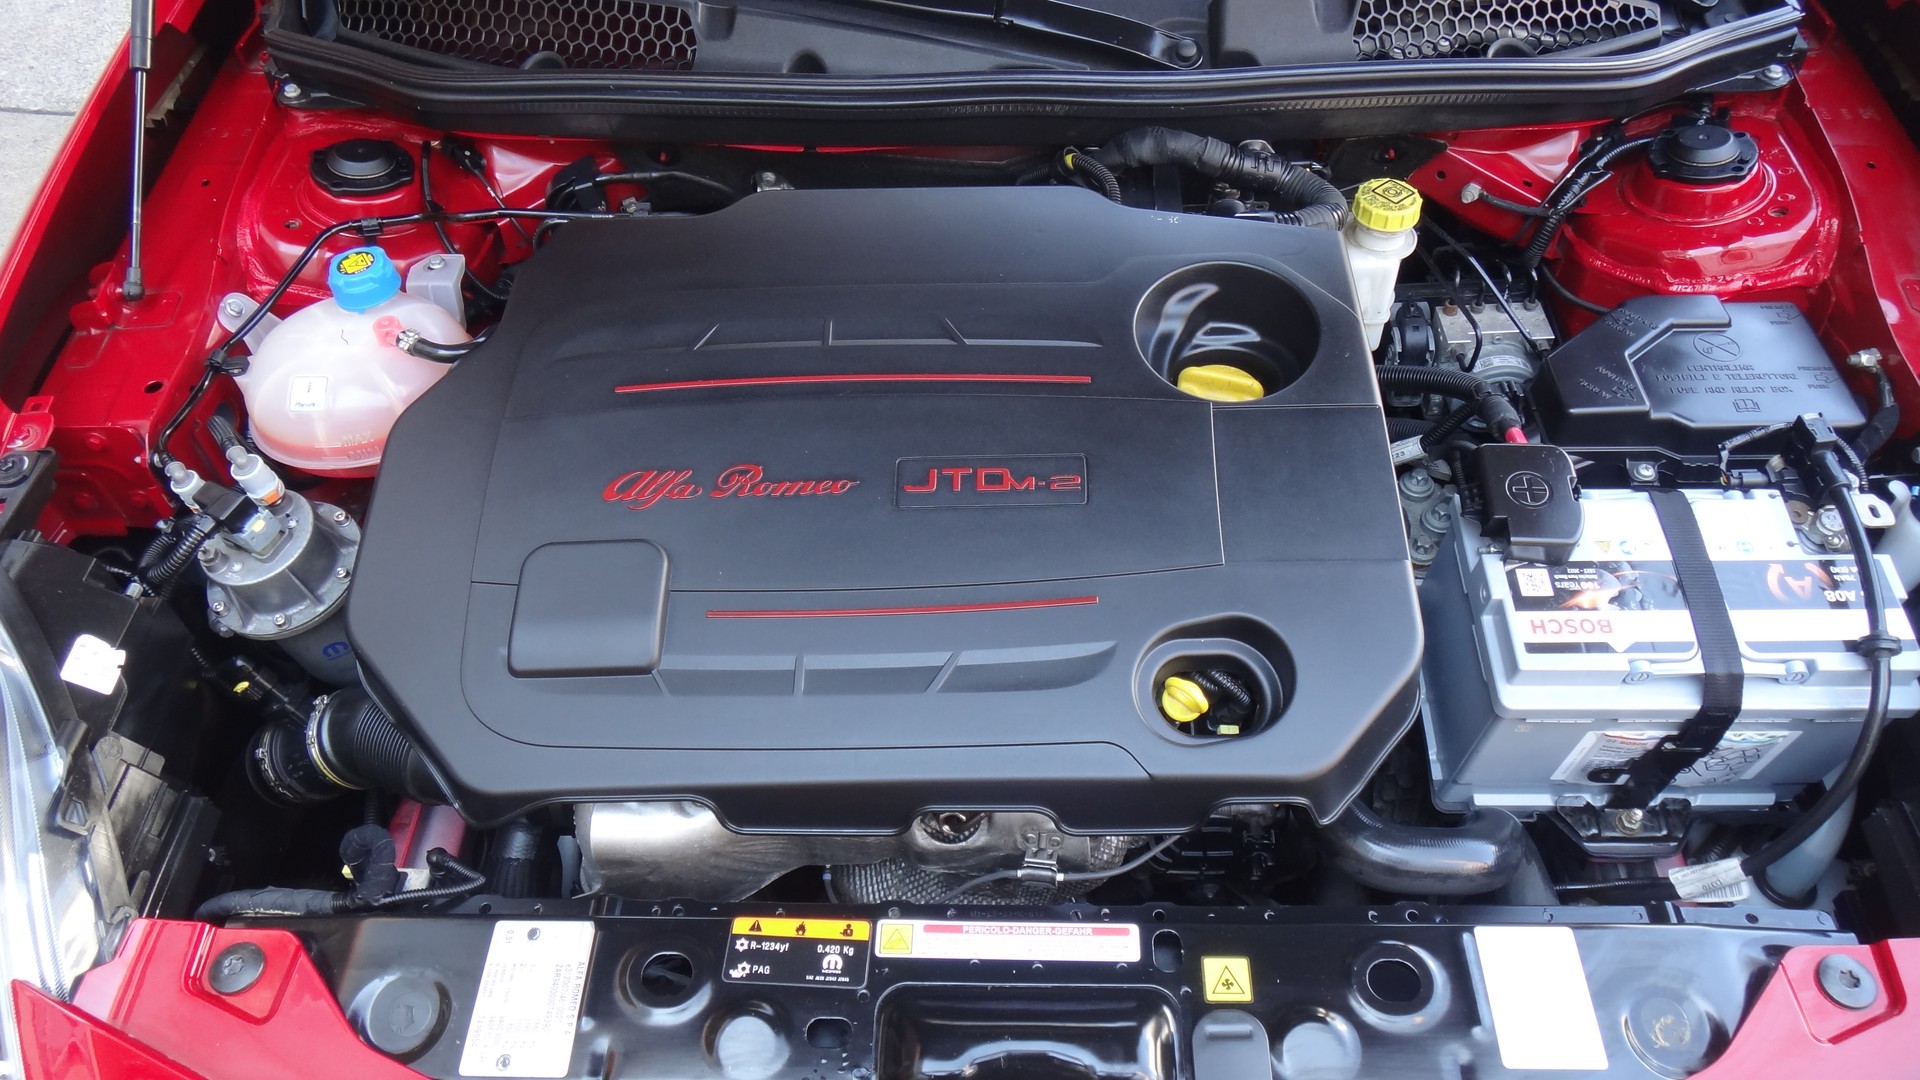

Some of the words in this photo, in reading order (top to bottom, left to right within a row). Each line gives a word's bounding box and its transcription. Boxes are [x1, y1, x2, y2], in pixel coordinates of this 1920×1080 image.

[602, 469, 702, 511] Alfa
[710, 465, 861, 498] Romeo
[1530, 618, 1613, 635] BOSCH
[962, 925, 1093, 936] PERICOLO-DANGER-GEFAHR
[750, 940, 790, 953] R-1234yf
[817, 944, 841, 954] 0.420
[842, 945, 855, 956] Kg
[575, 961, 586, 981] ALFA
[752, 964, 770, 975] PAG
[568, 983, 582, 1012] ROMEO
